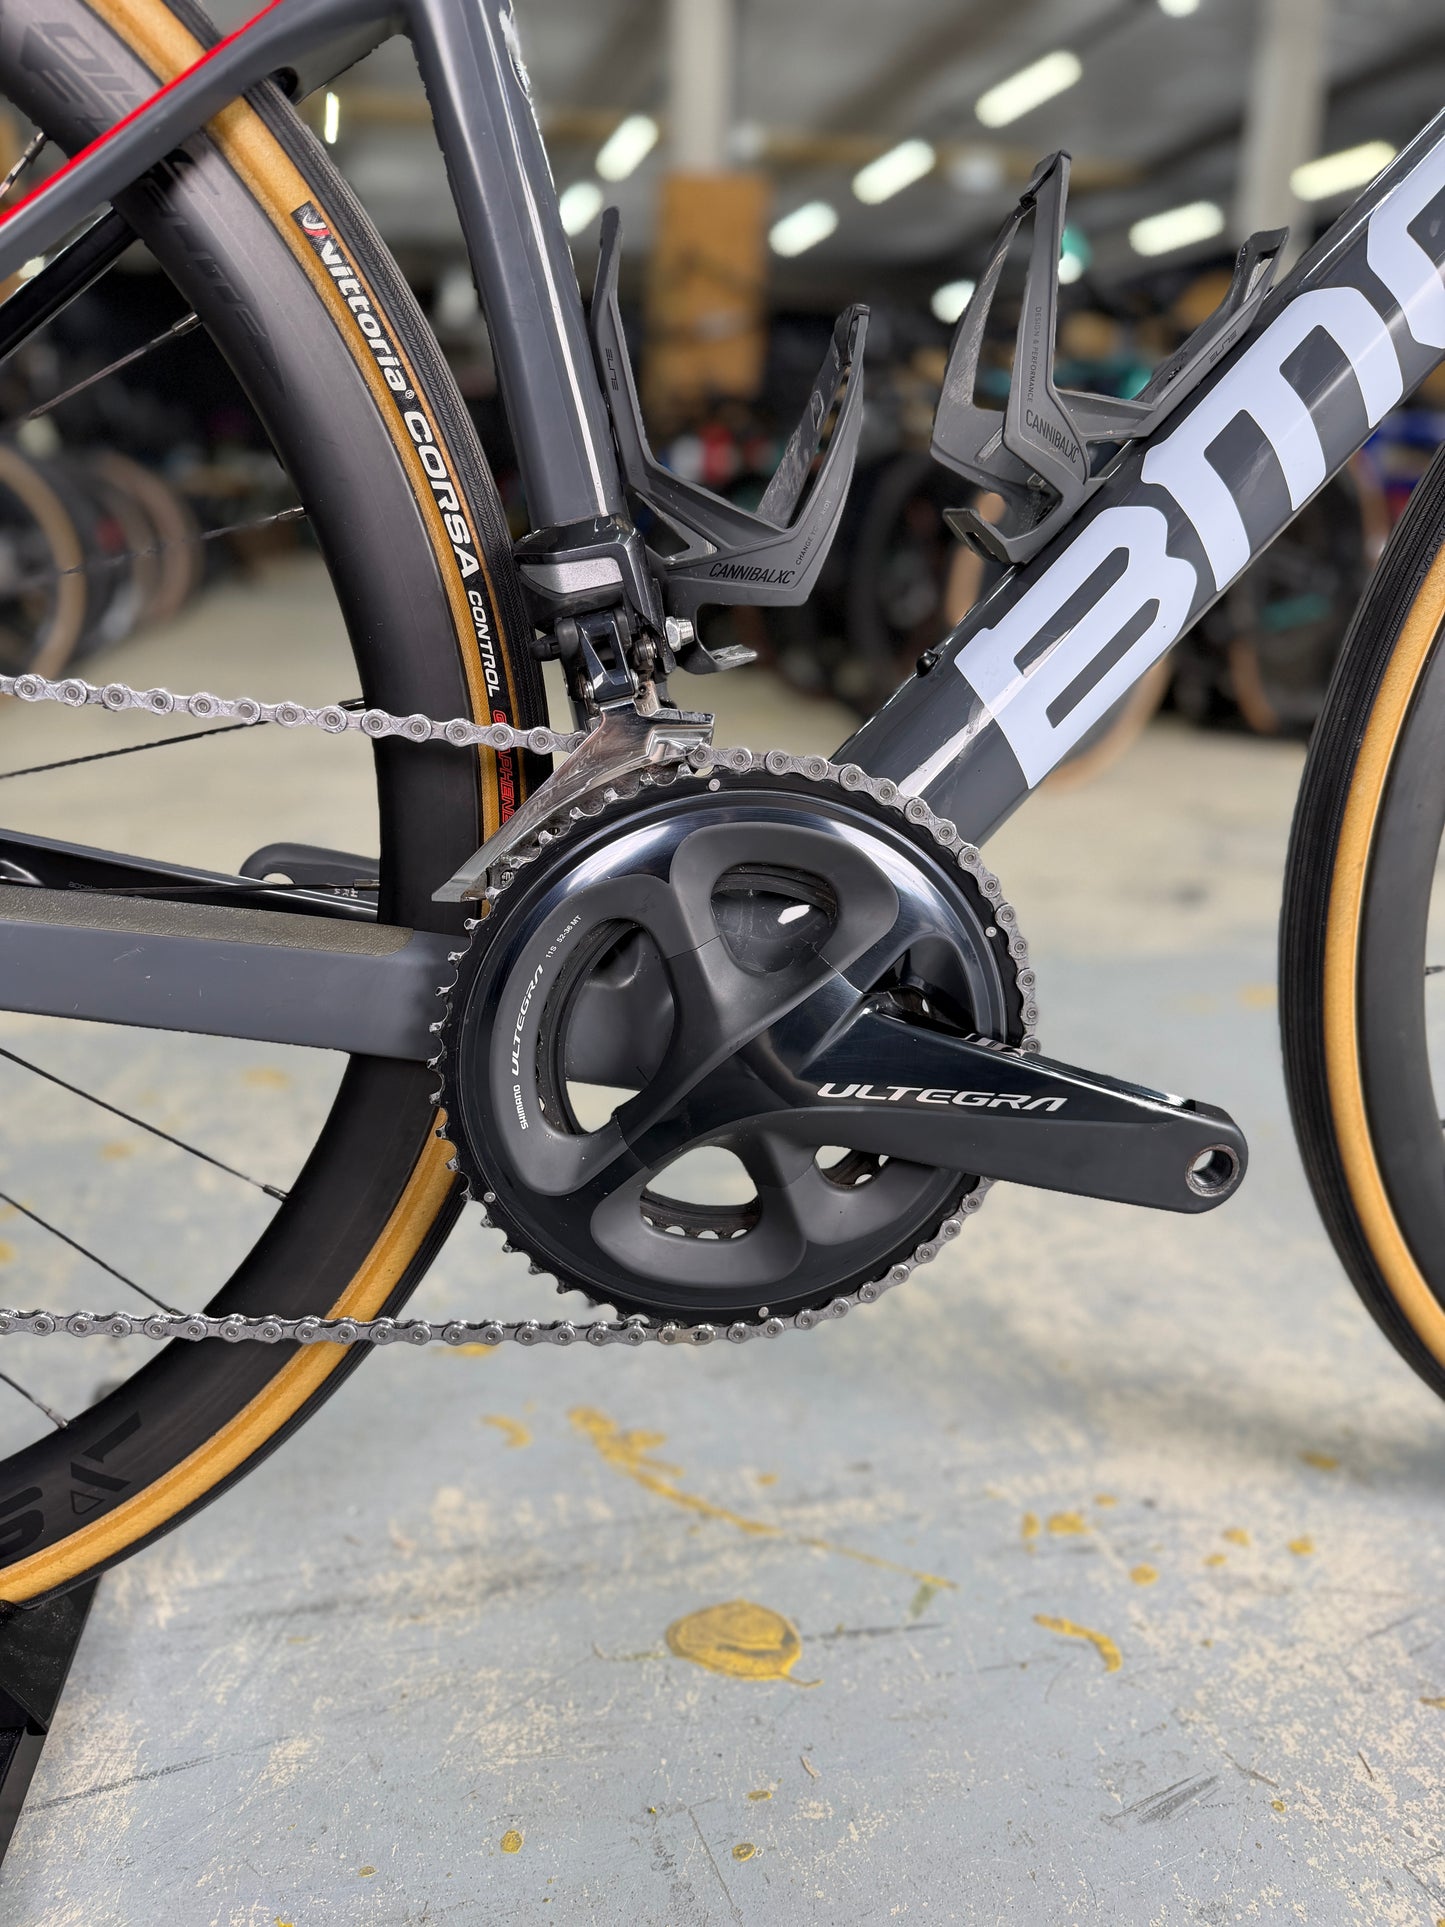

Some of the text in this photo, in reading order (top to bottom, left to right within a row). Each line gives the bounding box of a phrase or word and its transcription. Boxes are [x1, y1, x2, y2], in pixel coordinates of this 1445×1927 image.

[1025, 408, 1080, 464] CANNIBALXC
[709, 562, 796, 584] CANNIBALXC
[404, 411, 481, 579] CORSA
[467, 589, 501, 698] CONTROL
[492, 708, 516, 824] GPHENE
[511, 964, 544, 1076] ULTEGRA
[513, 1084, 529, 1130] SHIMANO
[816, 1082, 1070, 1112] ULTEGRA
